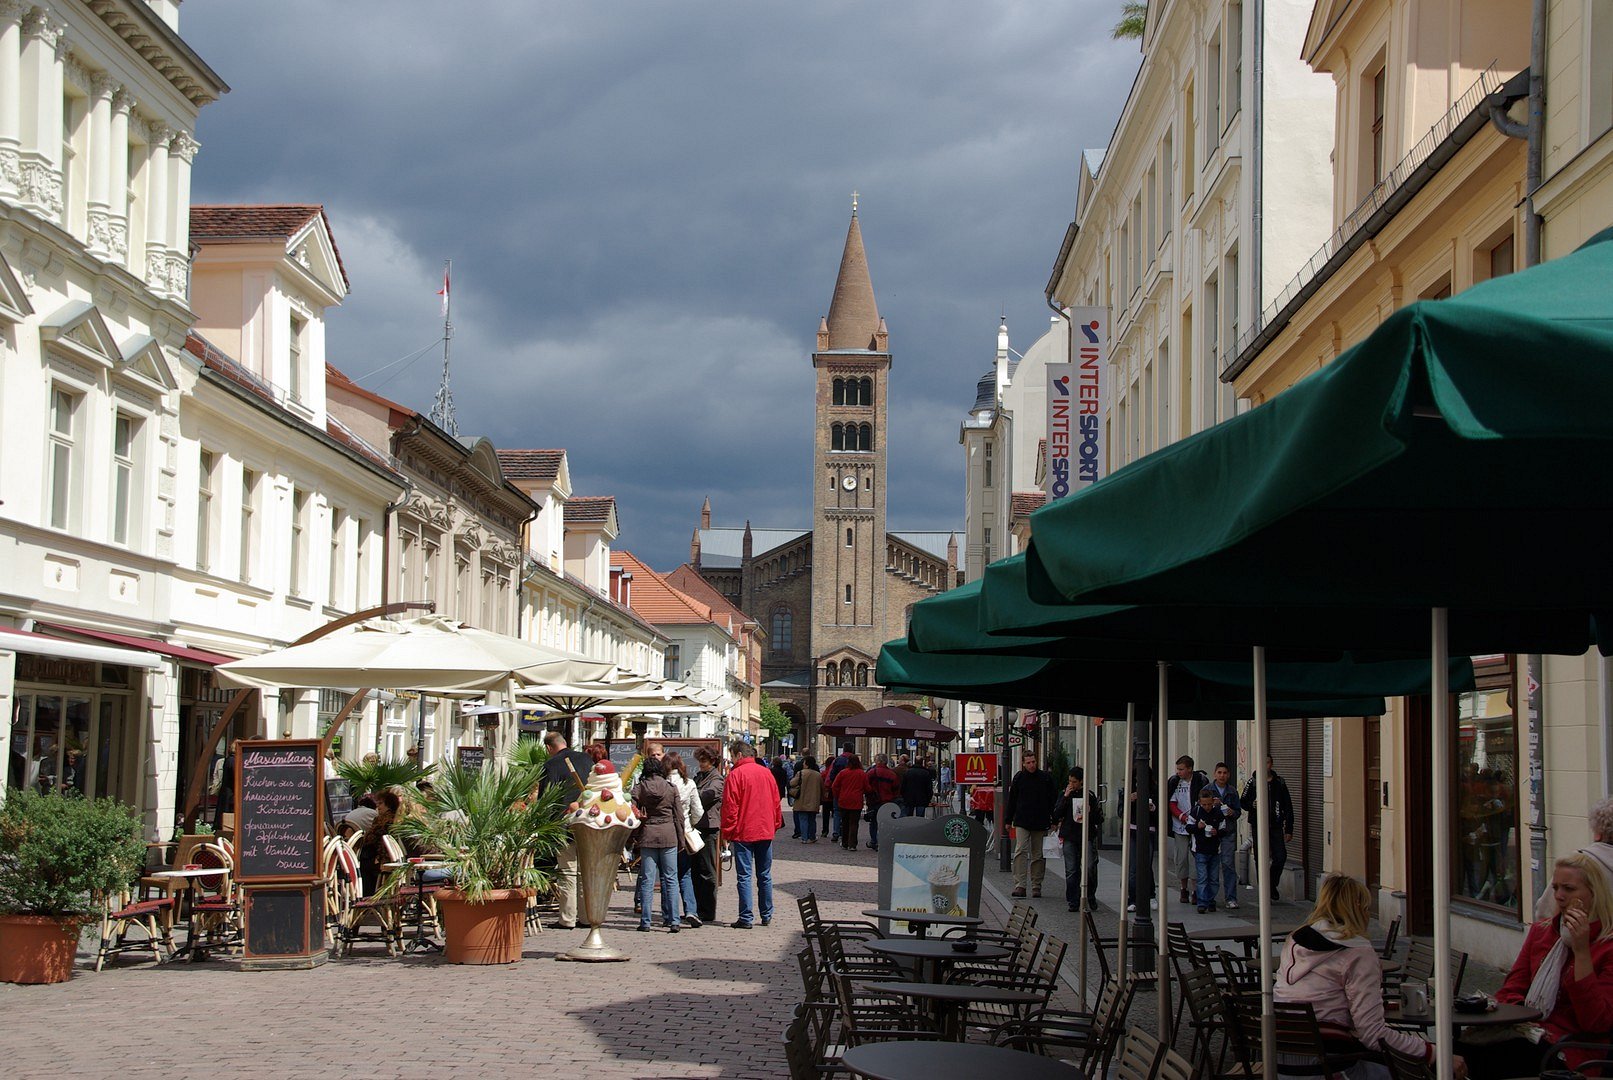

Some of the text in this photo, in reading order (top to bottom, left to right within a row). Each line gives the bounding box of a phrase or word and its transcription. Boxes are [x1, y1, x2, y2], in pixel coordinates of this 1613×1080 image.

[1079, 347, 1099, 483] INTERSPORT
[1052, 399, 1069, 500] INTERSPO
[244, 751, 315, 769] Maximilians
[244, 775, 313, 788] Kuchen aus der
[244, 790, 303, 806] hauseigenen
[256, 804, 313, 816] Konditorei
[243, 845, 258, 857] mit
